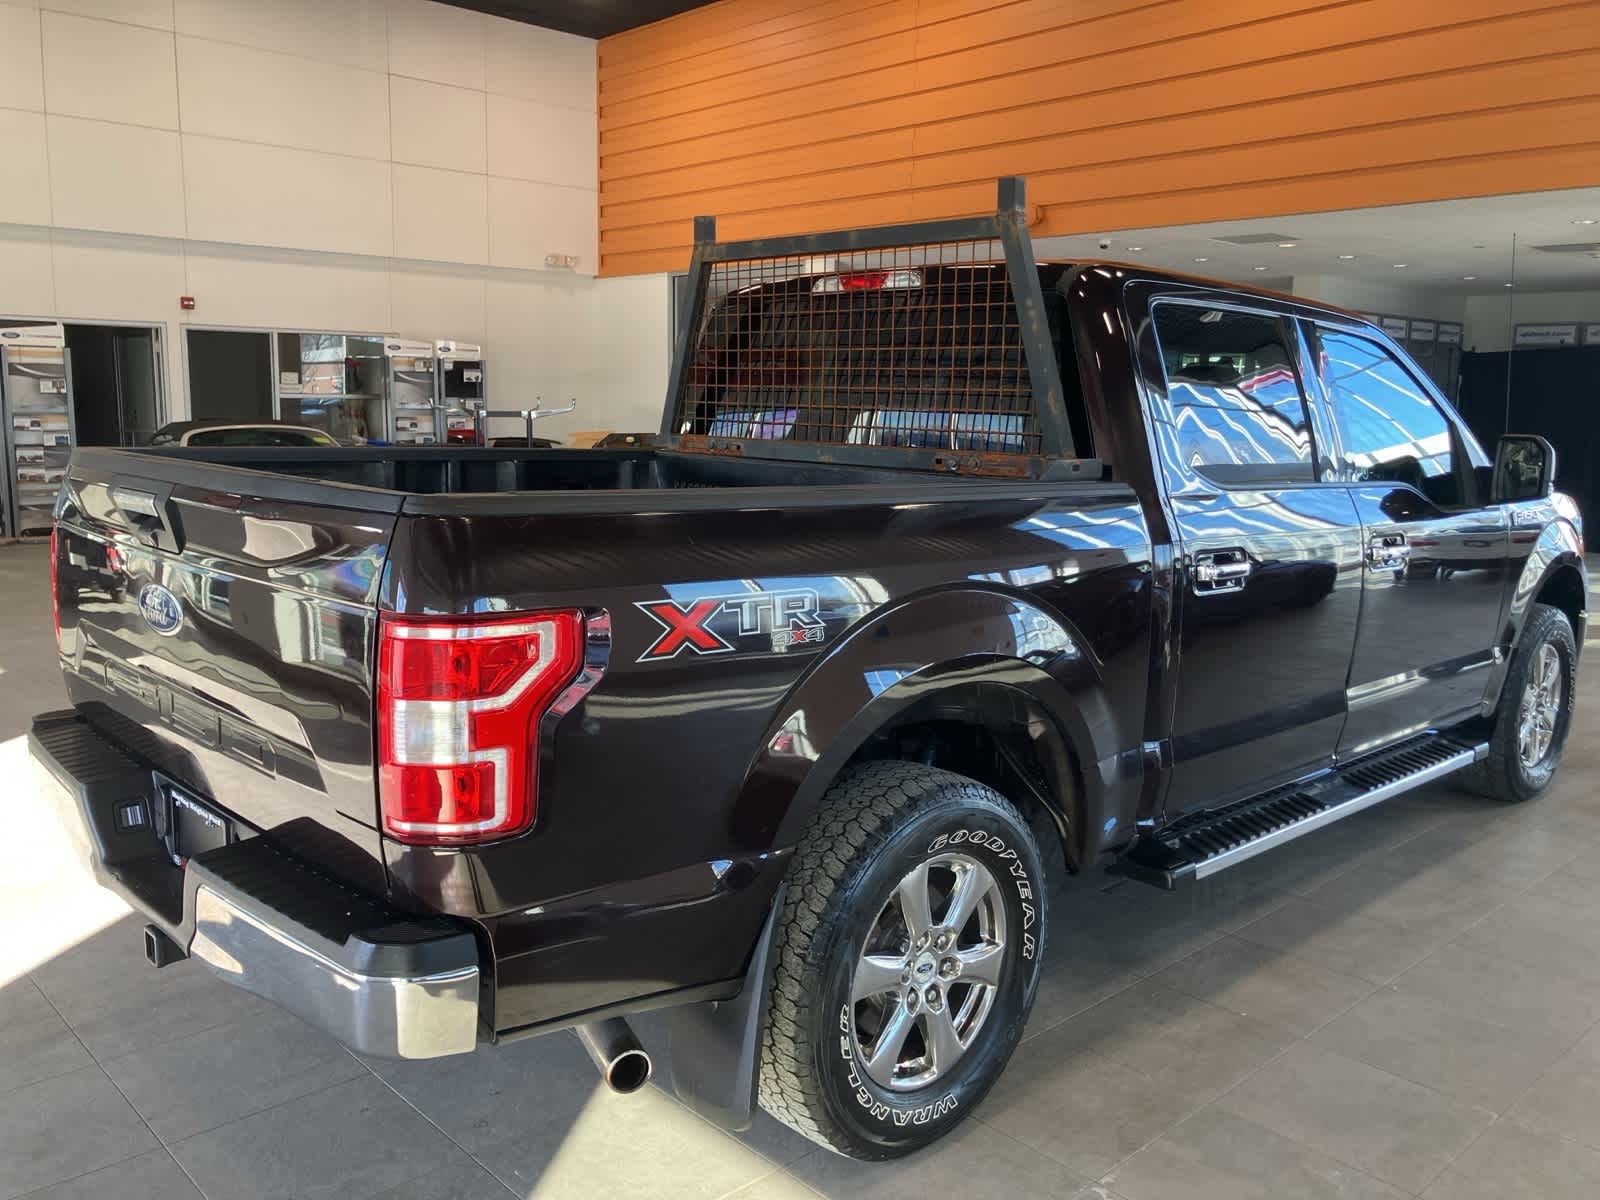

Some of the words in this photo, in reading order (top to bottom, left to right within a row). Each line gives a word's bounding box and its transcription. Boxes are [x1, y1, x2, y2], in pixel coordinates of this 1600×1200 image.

[632, 587, 827, 663] XTR
[927, 829, 1035, 960] GOODYEAR
[839, 1002, 958, 1127] WRANGLER
